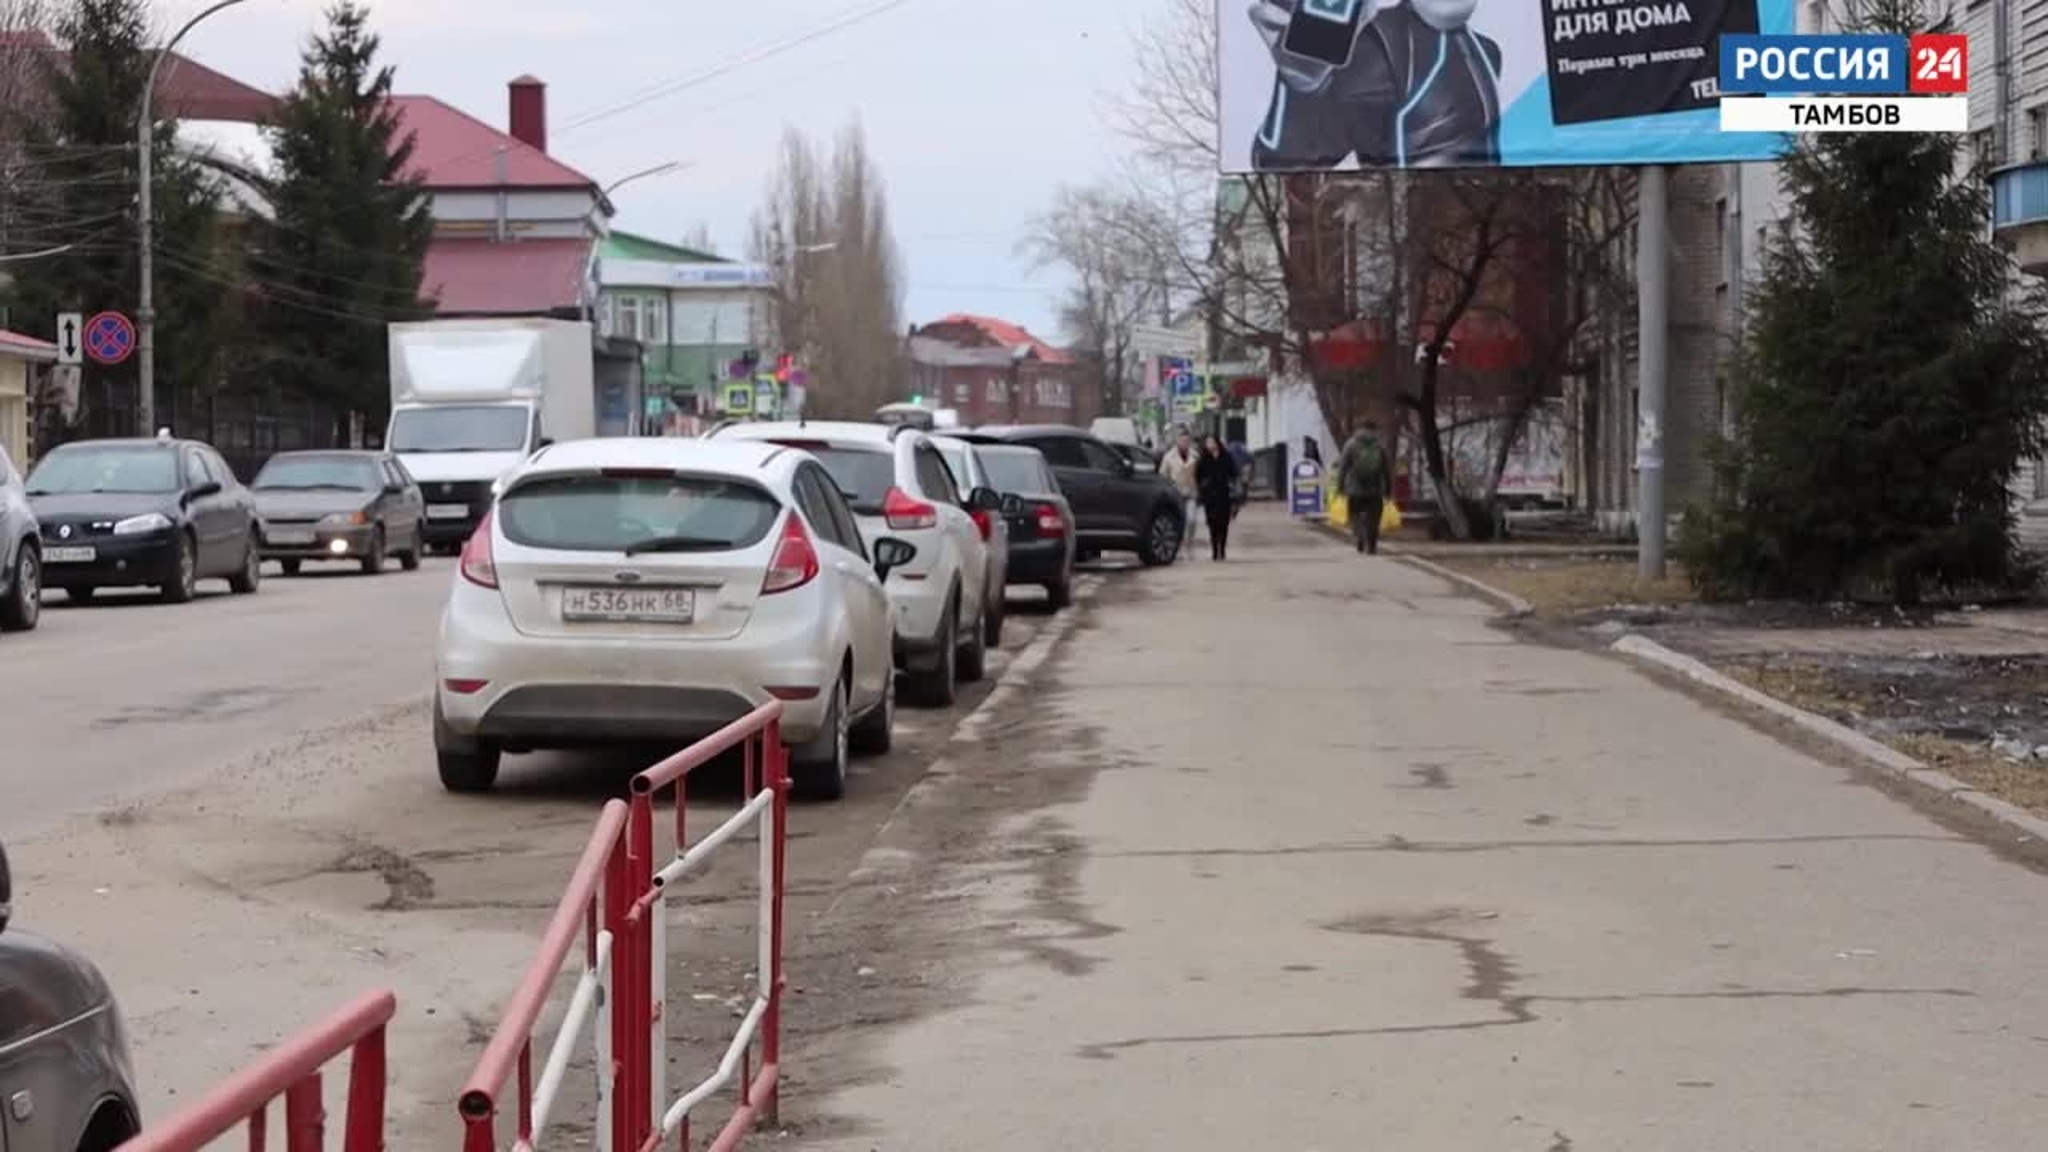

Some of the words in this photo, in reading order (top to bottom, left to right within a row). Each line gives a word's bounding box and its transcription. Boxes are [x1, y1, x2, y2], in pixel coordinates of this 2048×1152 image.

[1553, 12, 1609, 41] ДЛЯ
[1615, 2, 1692, 34] ДОМА
[1618, 50, 1643, 68] три
[1650, 45, 1706, 62] месяца
